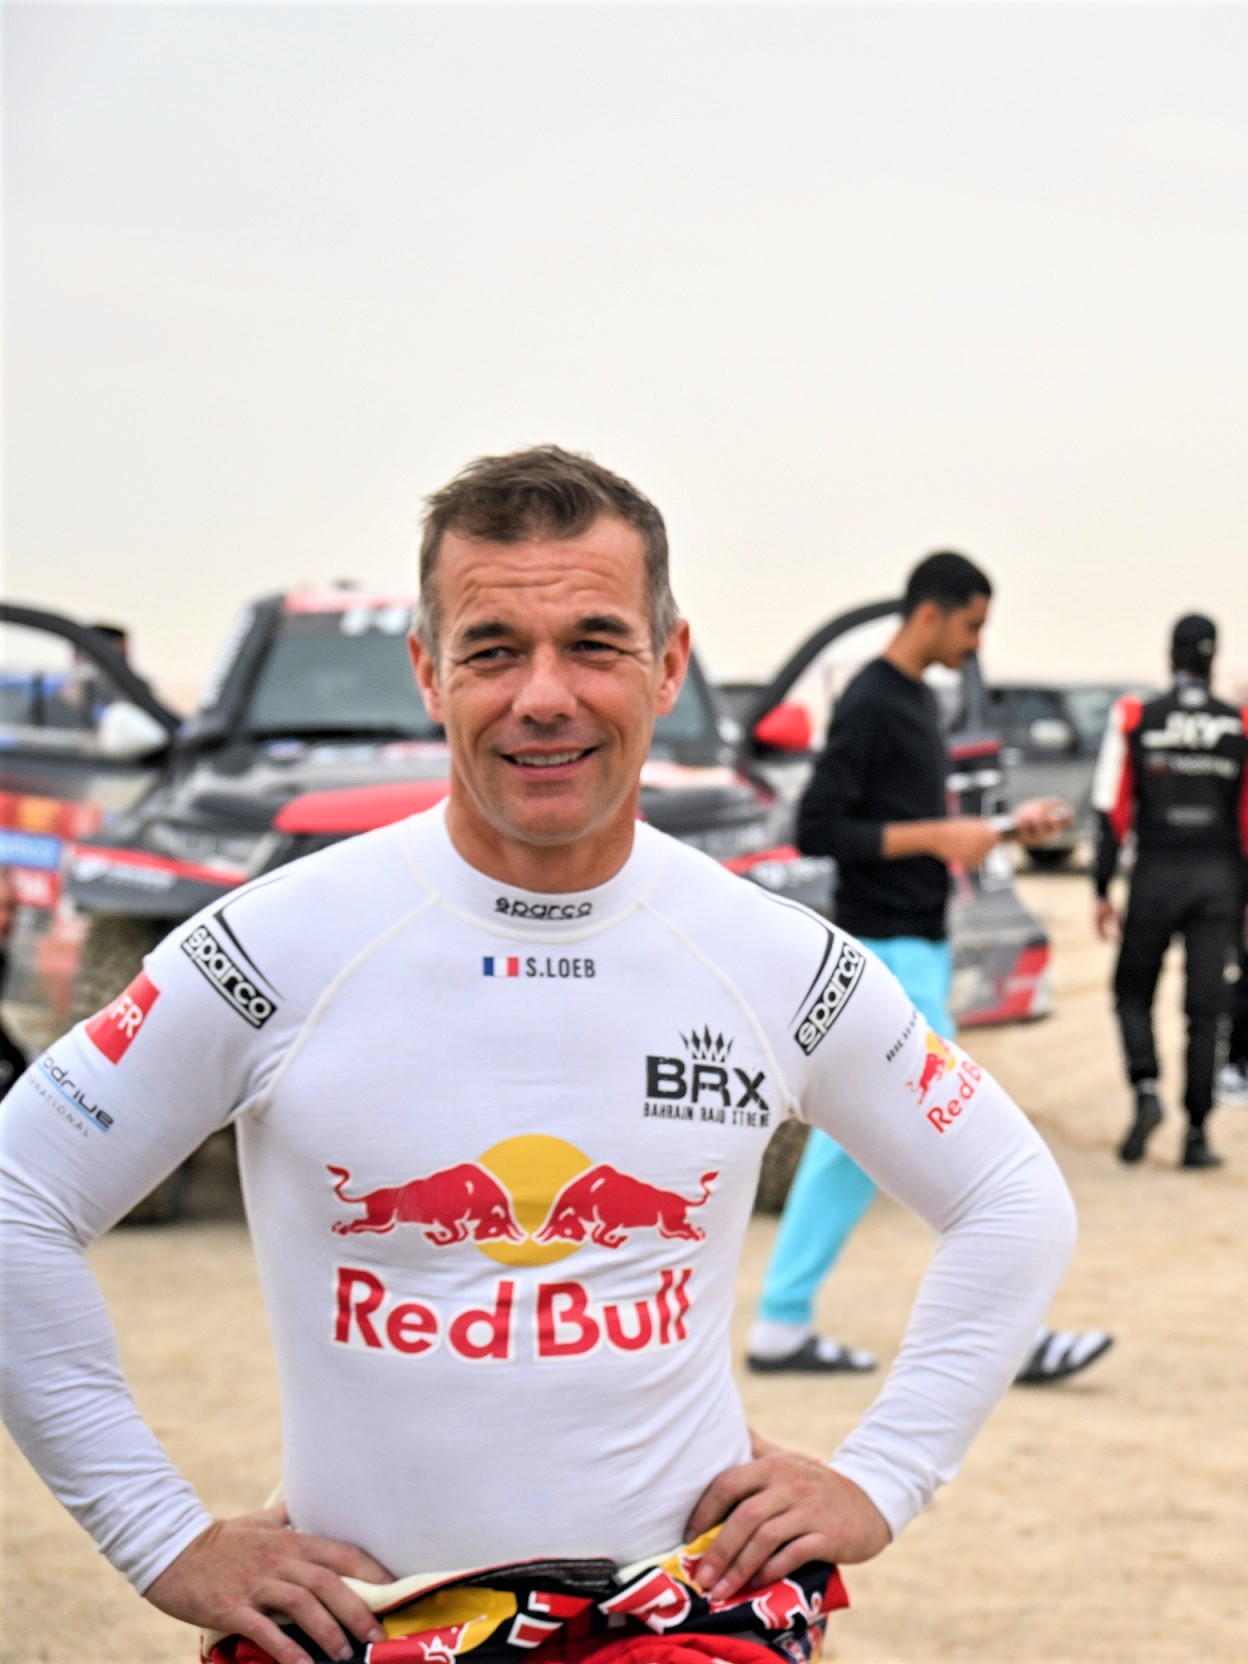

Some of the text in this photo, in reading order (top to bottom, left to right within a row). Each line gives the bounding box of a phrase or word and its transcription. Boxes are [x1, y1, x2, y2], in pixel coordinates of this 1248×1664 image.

[494, 896, 593, 920] sparco
[188, 927, 272, 1020] sparco
[526, 956, 596, 978] S.LOEB
[797, 943, 861, 1046] sparco
[43, 1056, 114, 1129] odrive
[643, 1102, 694, 1120] BAHRAIN
[646, 1055, 769, 1111] BRX
[926, 1071, 976, 1133] Red
[333, 1266, 693, 1360] Red Bull
